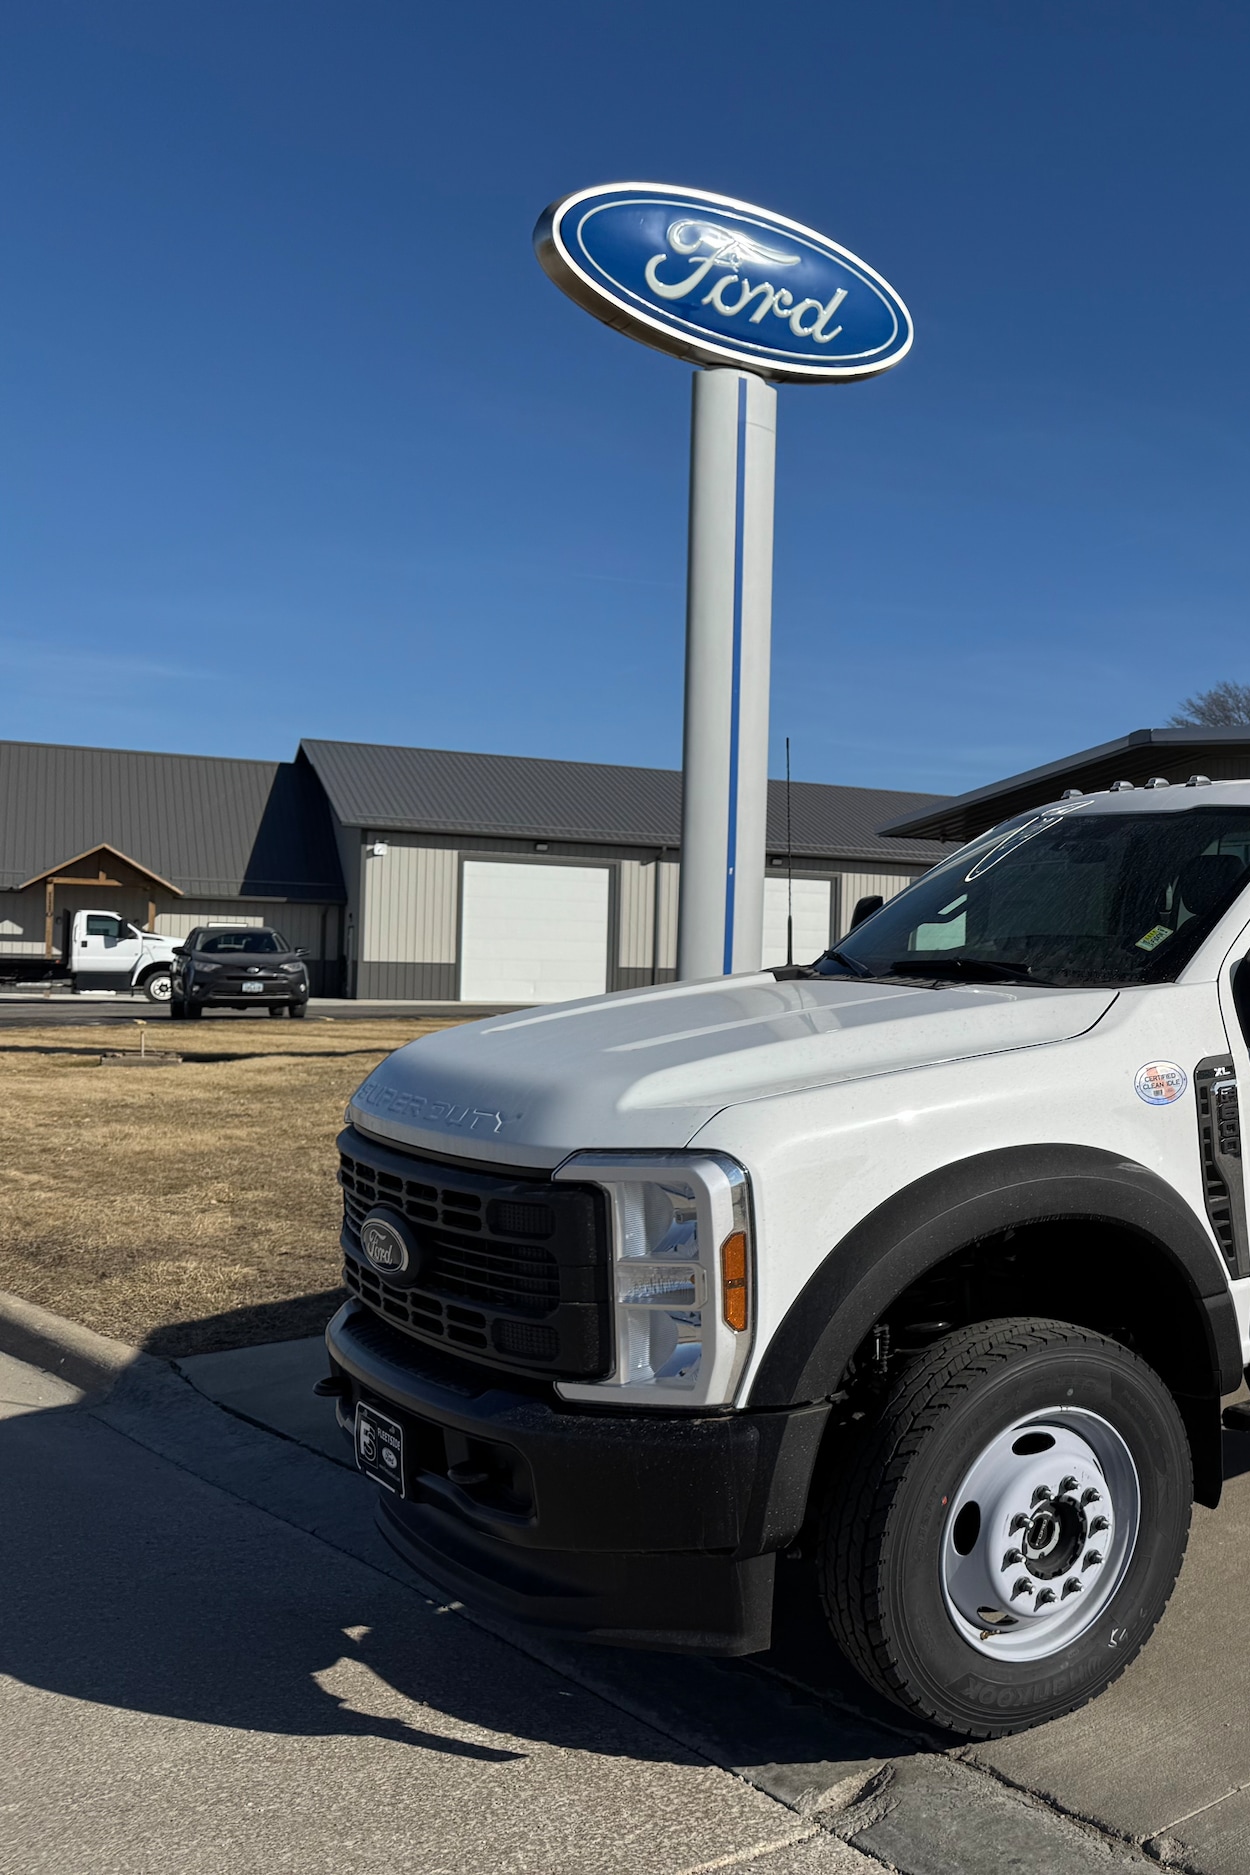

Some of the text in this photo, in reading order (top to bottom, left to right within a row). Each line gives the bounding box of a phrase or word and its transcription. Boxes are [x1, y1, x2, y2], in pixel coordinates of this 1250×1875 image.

[644, 218, 849, 344] Ford
[1144, 1072, 1176, 1083] CERTIFIED
[1213, 1067, 1231, 1077] XL
[1142, 1079, 1180, 1091] CLEAN IDLE
[356, 1082, 503, 1134] SUPER DUTY
[366, 1228, 393, 1265] Ford
[377, 1427, 401, 1452] FLEETSIDE
